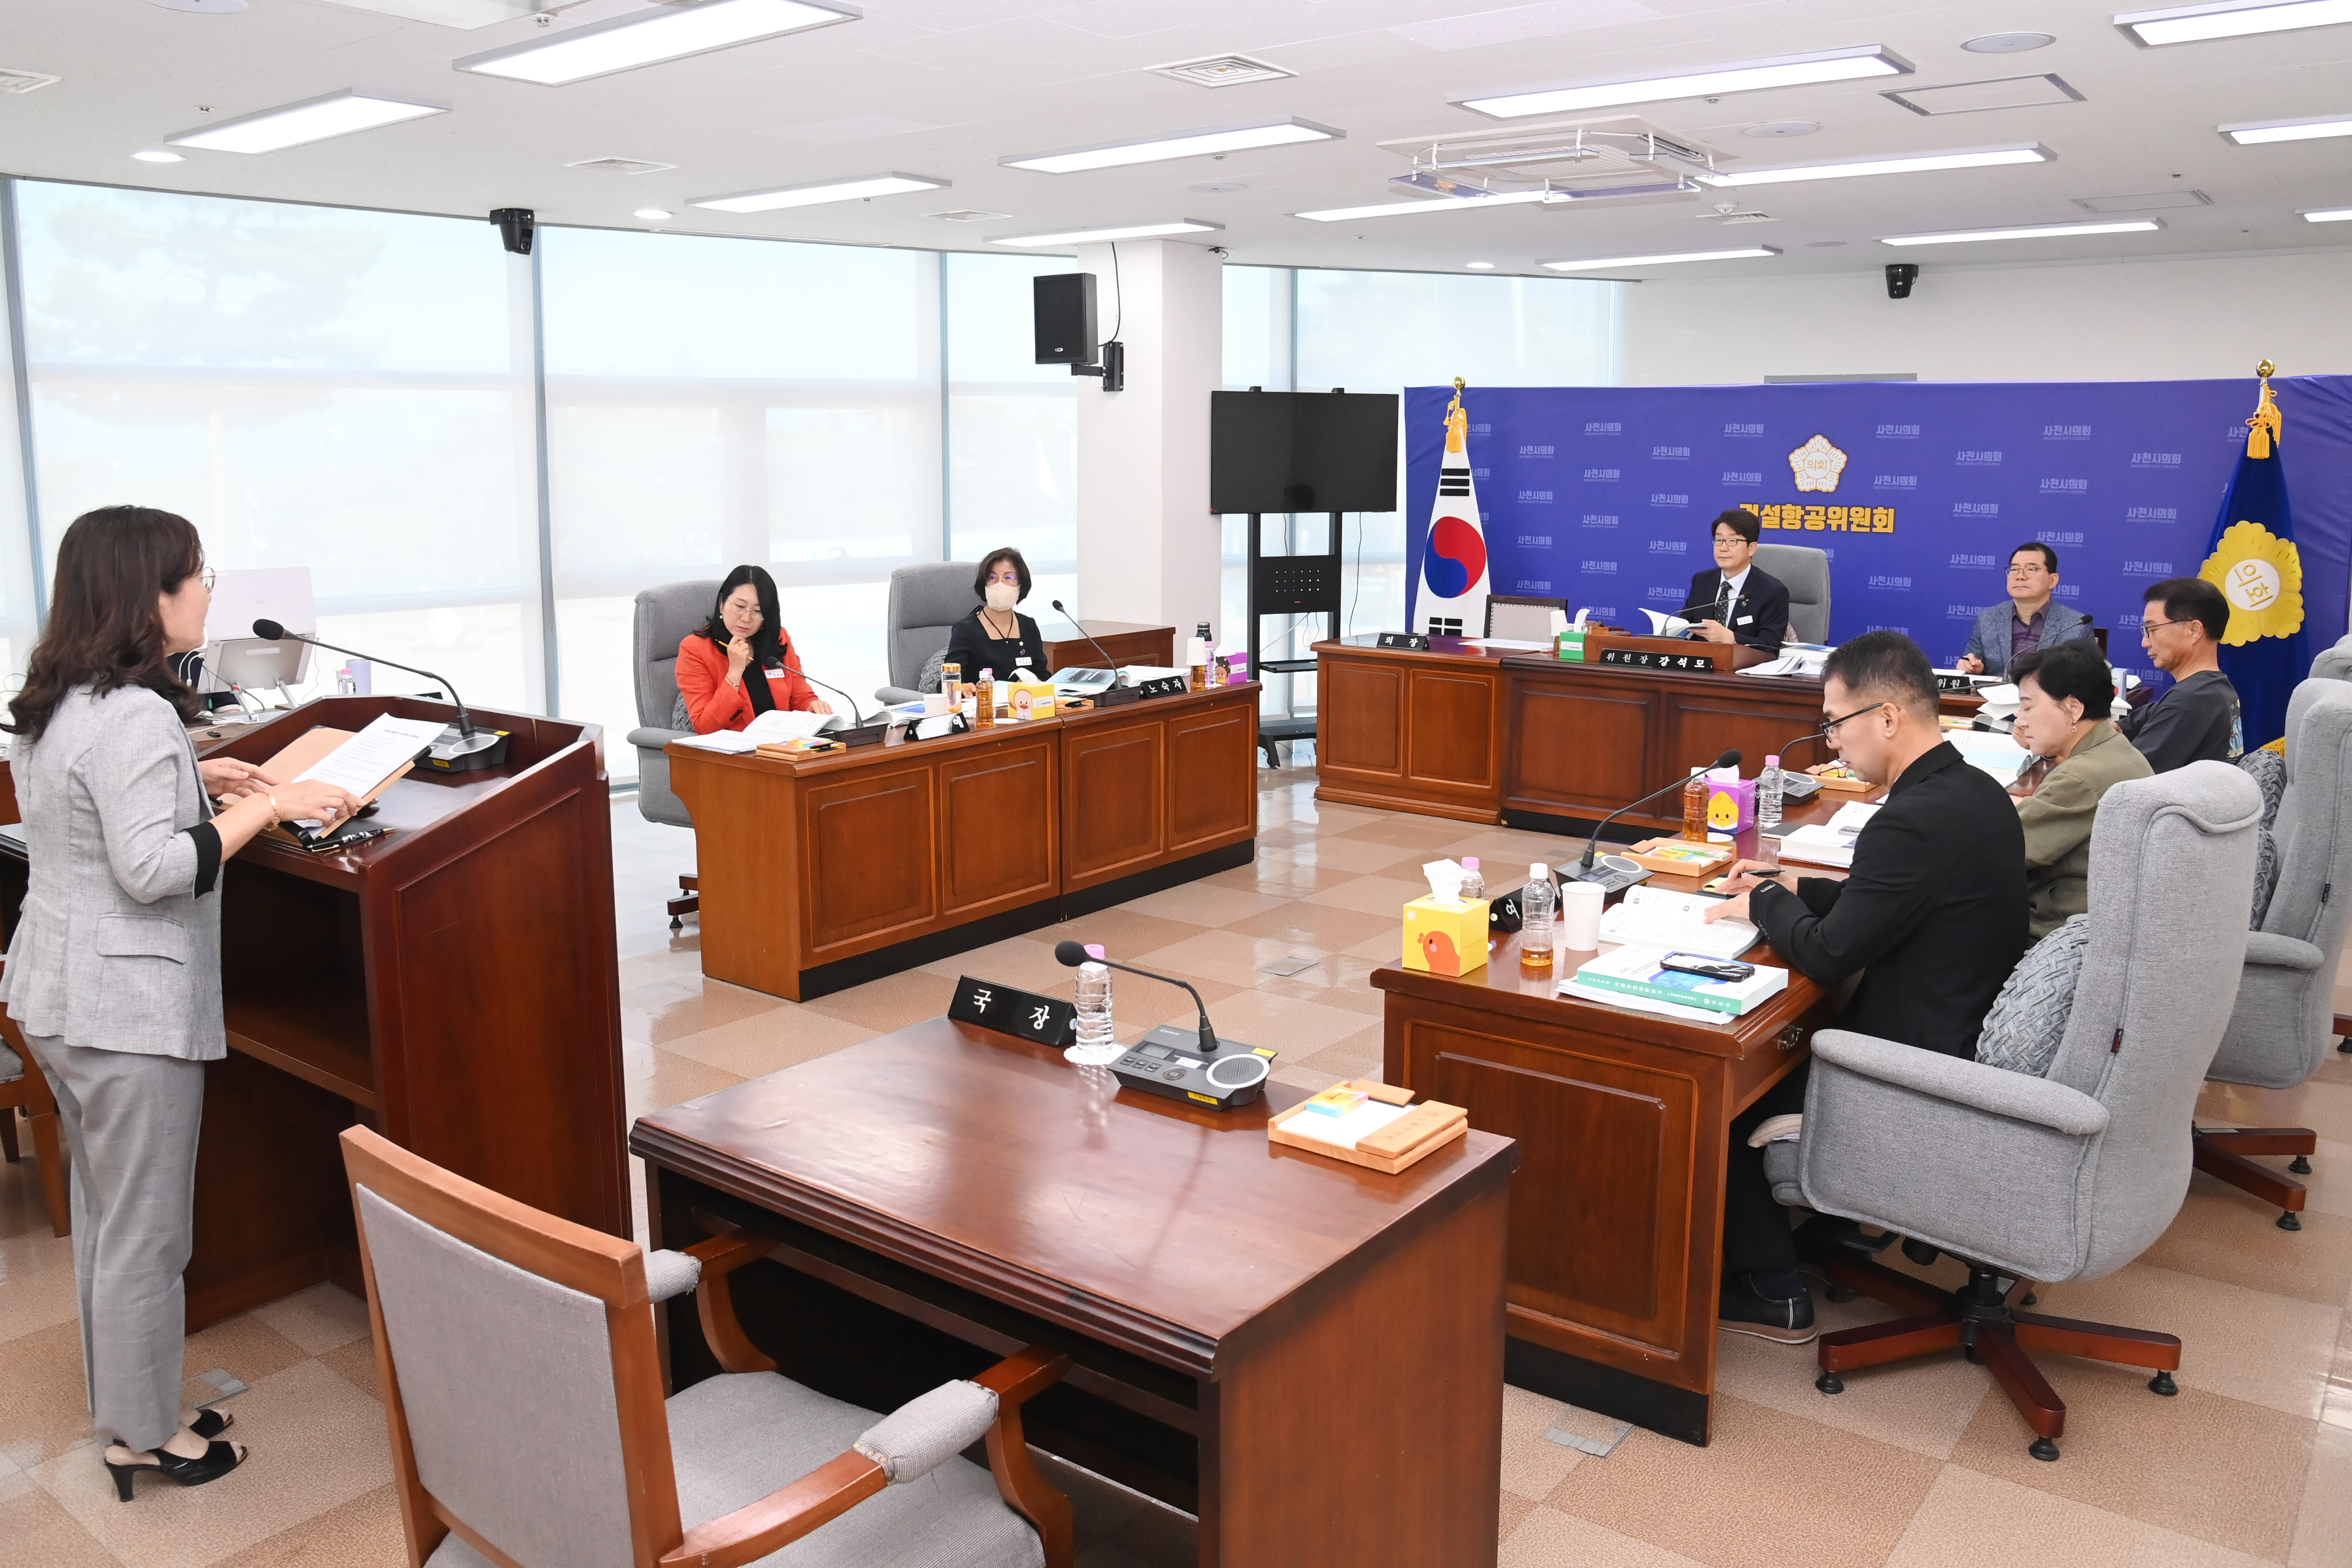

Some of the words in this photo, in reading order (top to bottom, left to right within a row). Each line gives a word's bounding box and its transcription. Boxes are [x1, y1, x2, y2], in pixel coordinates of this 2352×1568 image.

[1467, 424, 1491, 432] 시의회
[1585, 422, 1621, 432] 사천시의회
[1724, 423, 1764, 433] 사천시의회
[1876, 425, 1919, 435] 사천시의회
[2043, 425, 2091, 436] 사천시의회
[1519, 445, 1554, 455] 사천시의회
[1652, 446, 1690, 456] 사천시의회
[1956, 451, 2001, 461] 사천시의회
[2131, 453, 2180, 464] 사천시의회
[1807, 459, 1827, 471] 의회
[1472, 468, 1490, 477] 시의회
[1584, 469, 1620, 478] 사천시의회
[1722, 472, 1761, 482] 사천시의회
[1873, 475, 1916, 485] 사천시의회
[2039, 479, 2087, 489] 사천시의회
[1518, 490, 1553, 500] 사천시의회
[1651, 493, 1688, 504] 사천시의회
[1953, 503, 1998, 513] 사천시의회
[2126, 507, 2176, 519] 사천시의회
[1582, 514, 1618, 524] 사천시의회
[1517, 535, 1552, 545] 사천시의회
[2037, 531, 2083, 543] 사천시의회
[1649, 540, 1686, 551] 사천시의회
[1950, 554, 1995, 565] 사천시의회
[1581, 561, 1617, 570] 사천시의회
[2123, 561, 2172, 574] 사천시의회
[1516, 580, 1551, 590] 사천시의회
[1868, 575, 1911, 586] 사천시의회
[2051, 585, 2079, 596] 시의회
[2234, 564, 2273, 608] 의회
[1647, 587, 1685, 598] 사천시의회
[1947, 605, 1982, 616] 사천시의
[1385, 636, 1418, 647] 의장
[1606, 652, 1648, 664] 위원장
[1659, 656, 1705, 668] 강석모
[1148, 678, 1181, 693] 노숙자
[974, 988, 1050, 1030] 국장
